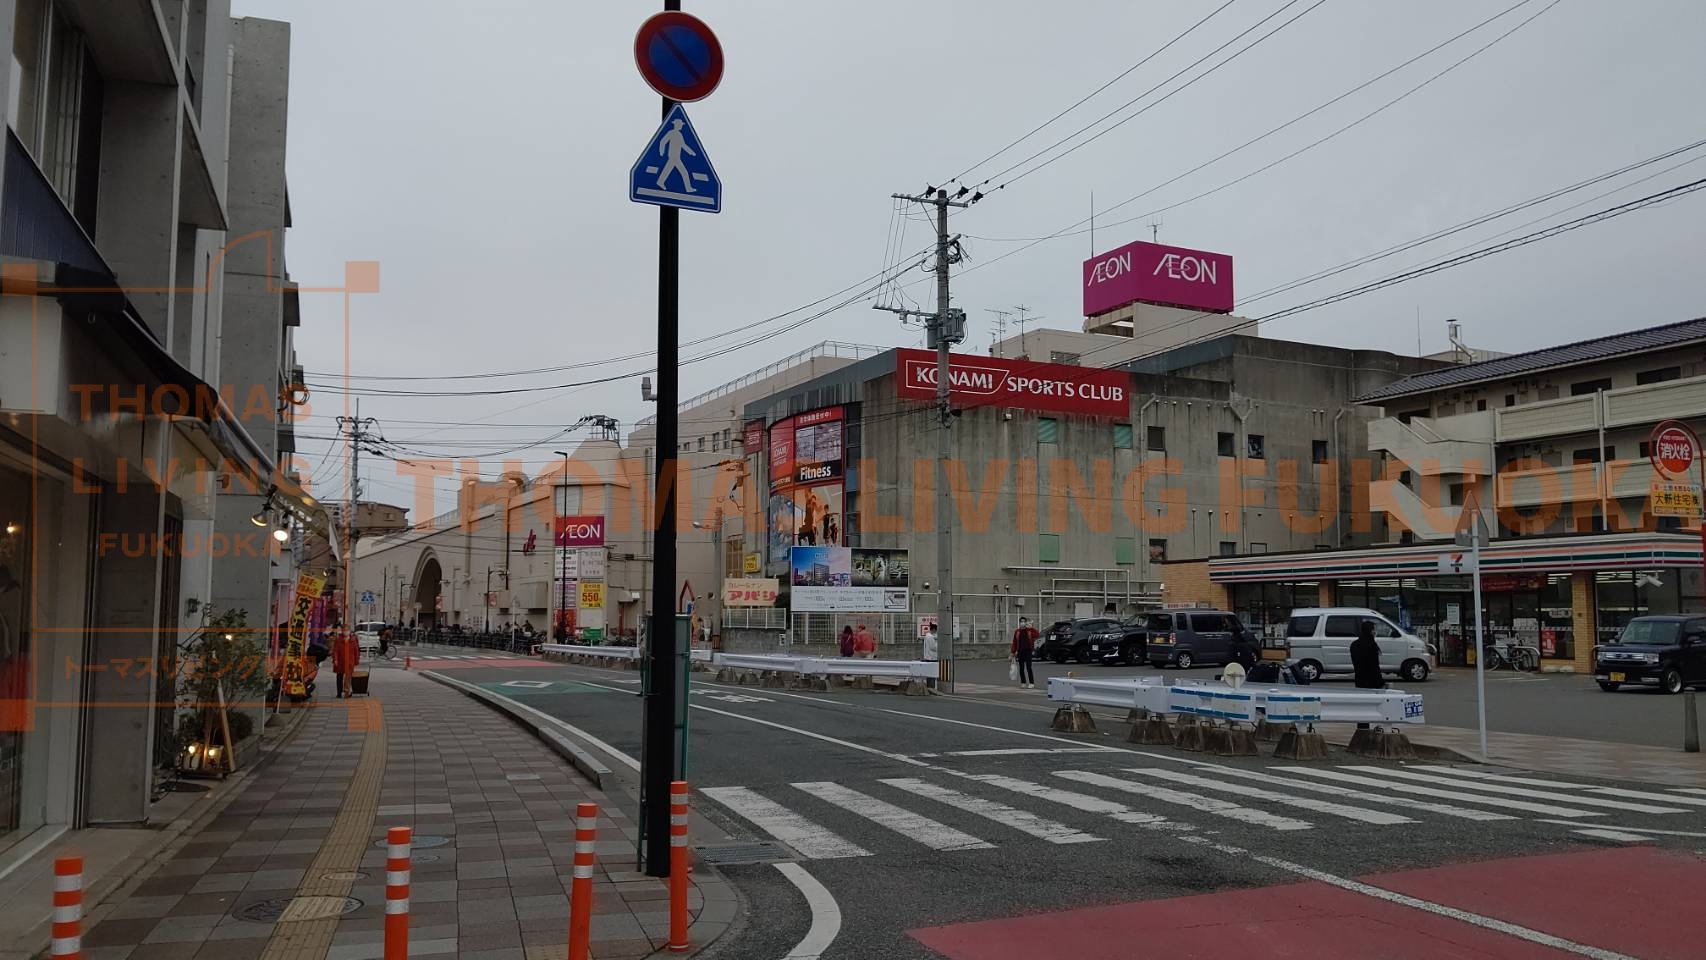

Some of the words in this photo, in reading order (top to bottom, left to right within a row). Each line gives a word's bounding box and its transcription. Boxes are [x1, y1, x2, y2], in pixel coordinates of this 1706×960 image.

[1007, 376, 1075, 397] SPORTS
[1078, 383, 1123, 401] CLUB
[1660, 442, 1691, 461] 消火栓
[800, 466, 832, 480] Fitness
